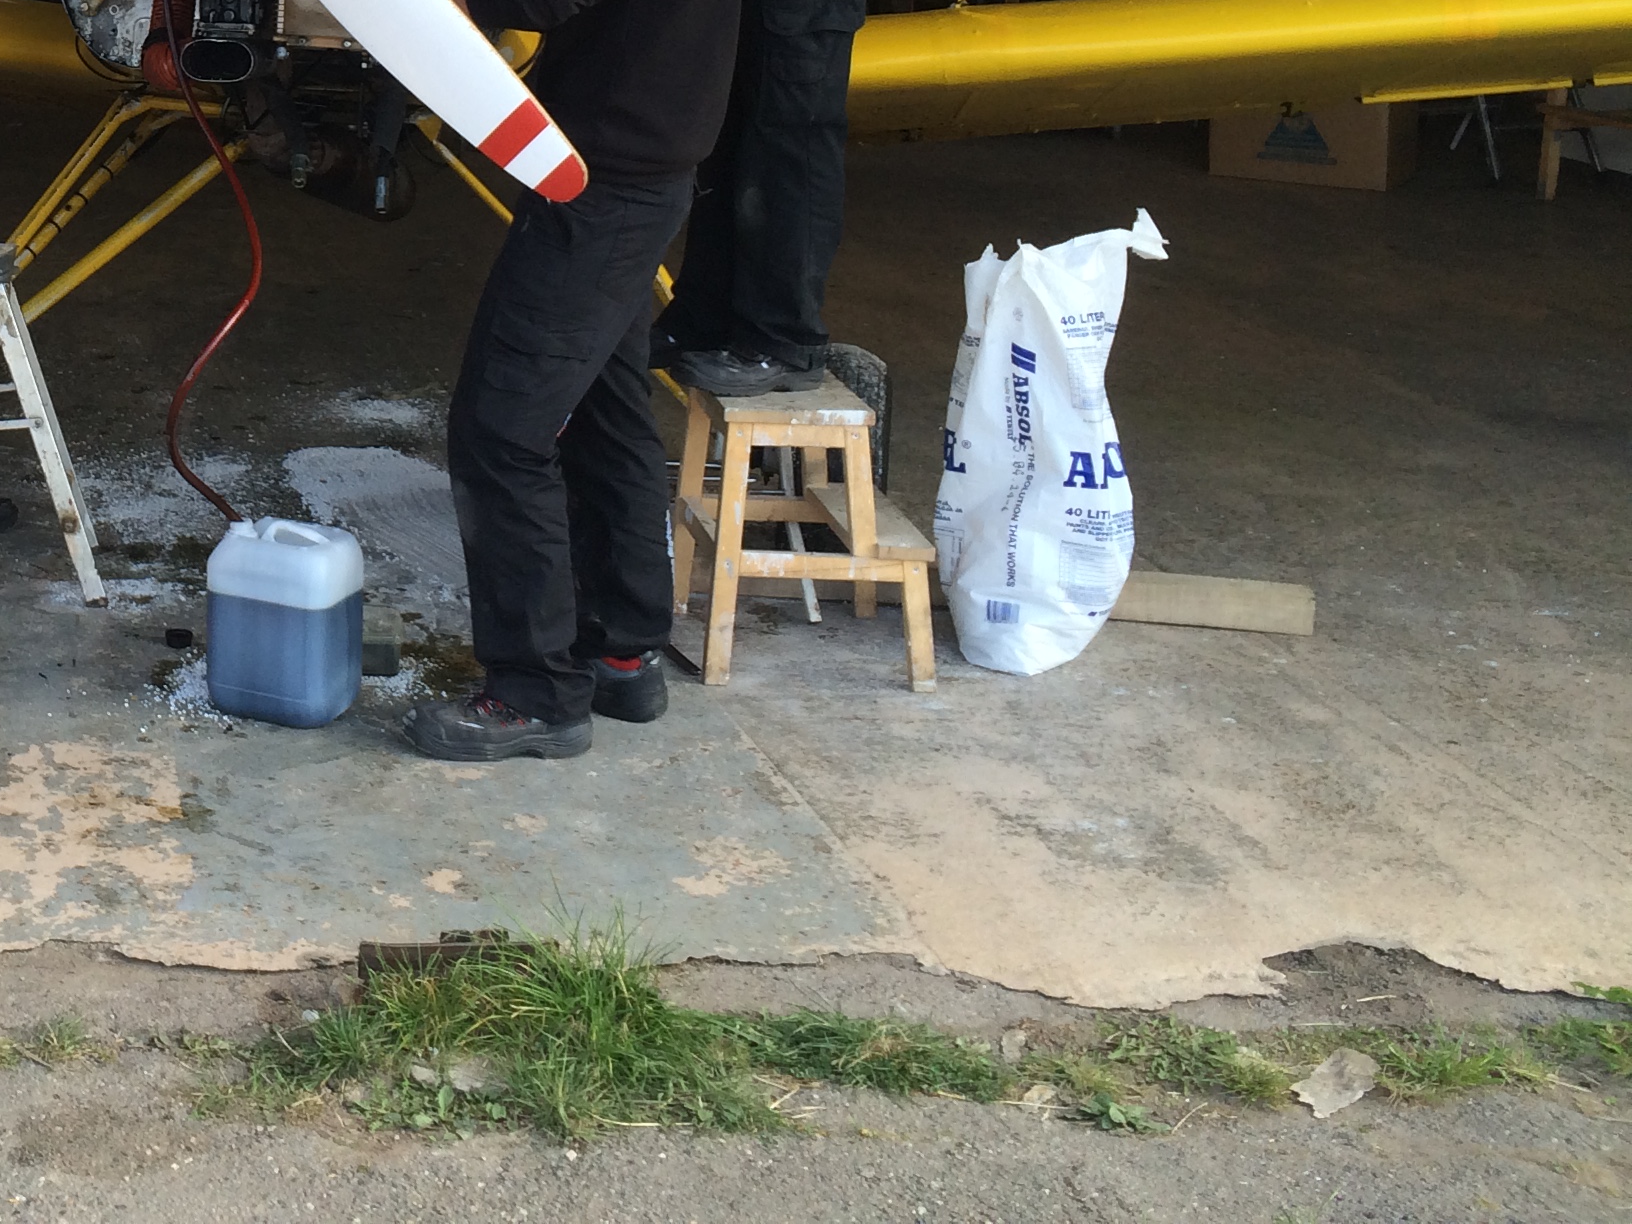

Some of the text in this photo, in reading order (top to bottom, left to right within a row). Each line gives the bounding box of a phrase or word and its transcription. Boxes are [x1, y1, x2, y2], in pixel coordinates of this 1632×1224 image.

[1060, 316, 1076, 325] 40
[1012, 373, 1033, 445] ABSOL
[1006, 452, 1036, 588] THE SOLUTION THAT WORKS
[1065, 507, 1083, 517] 40
